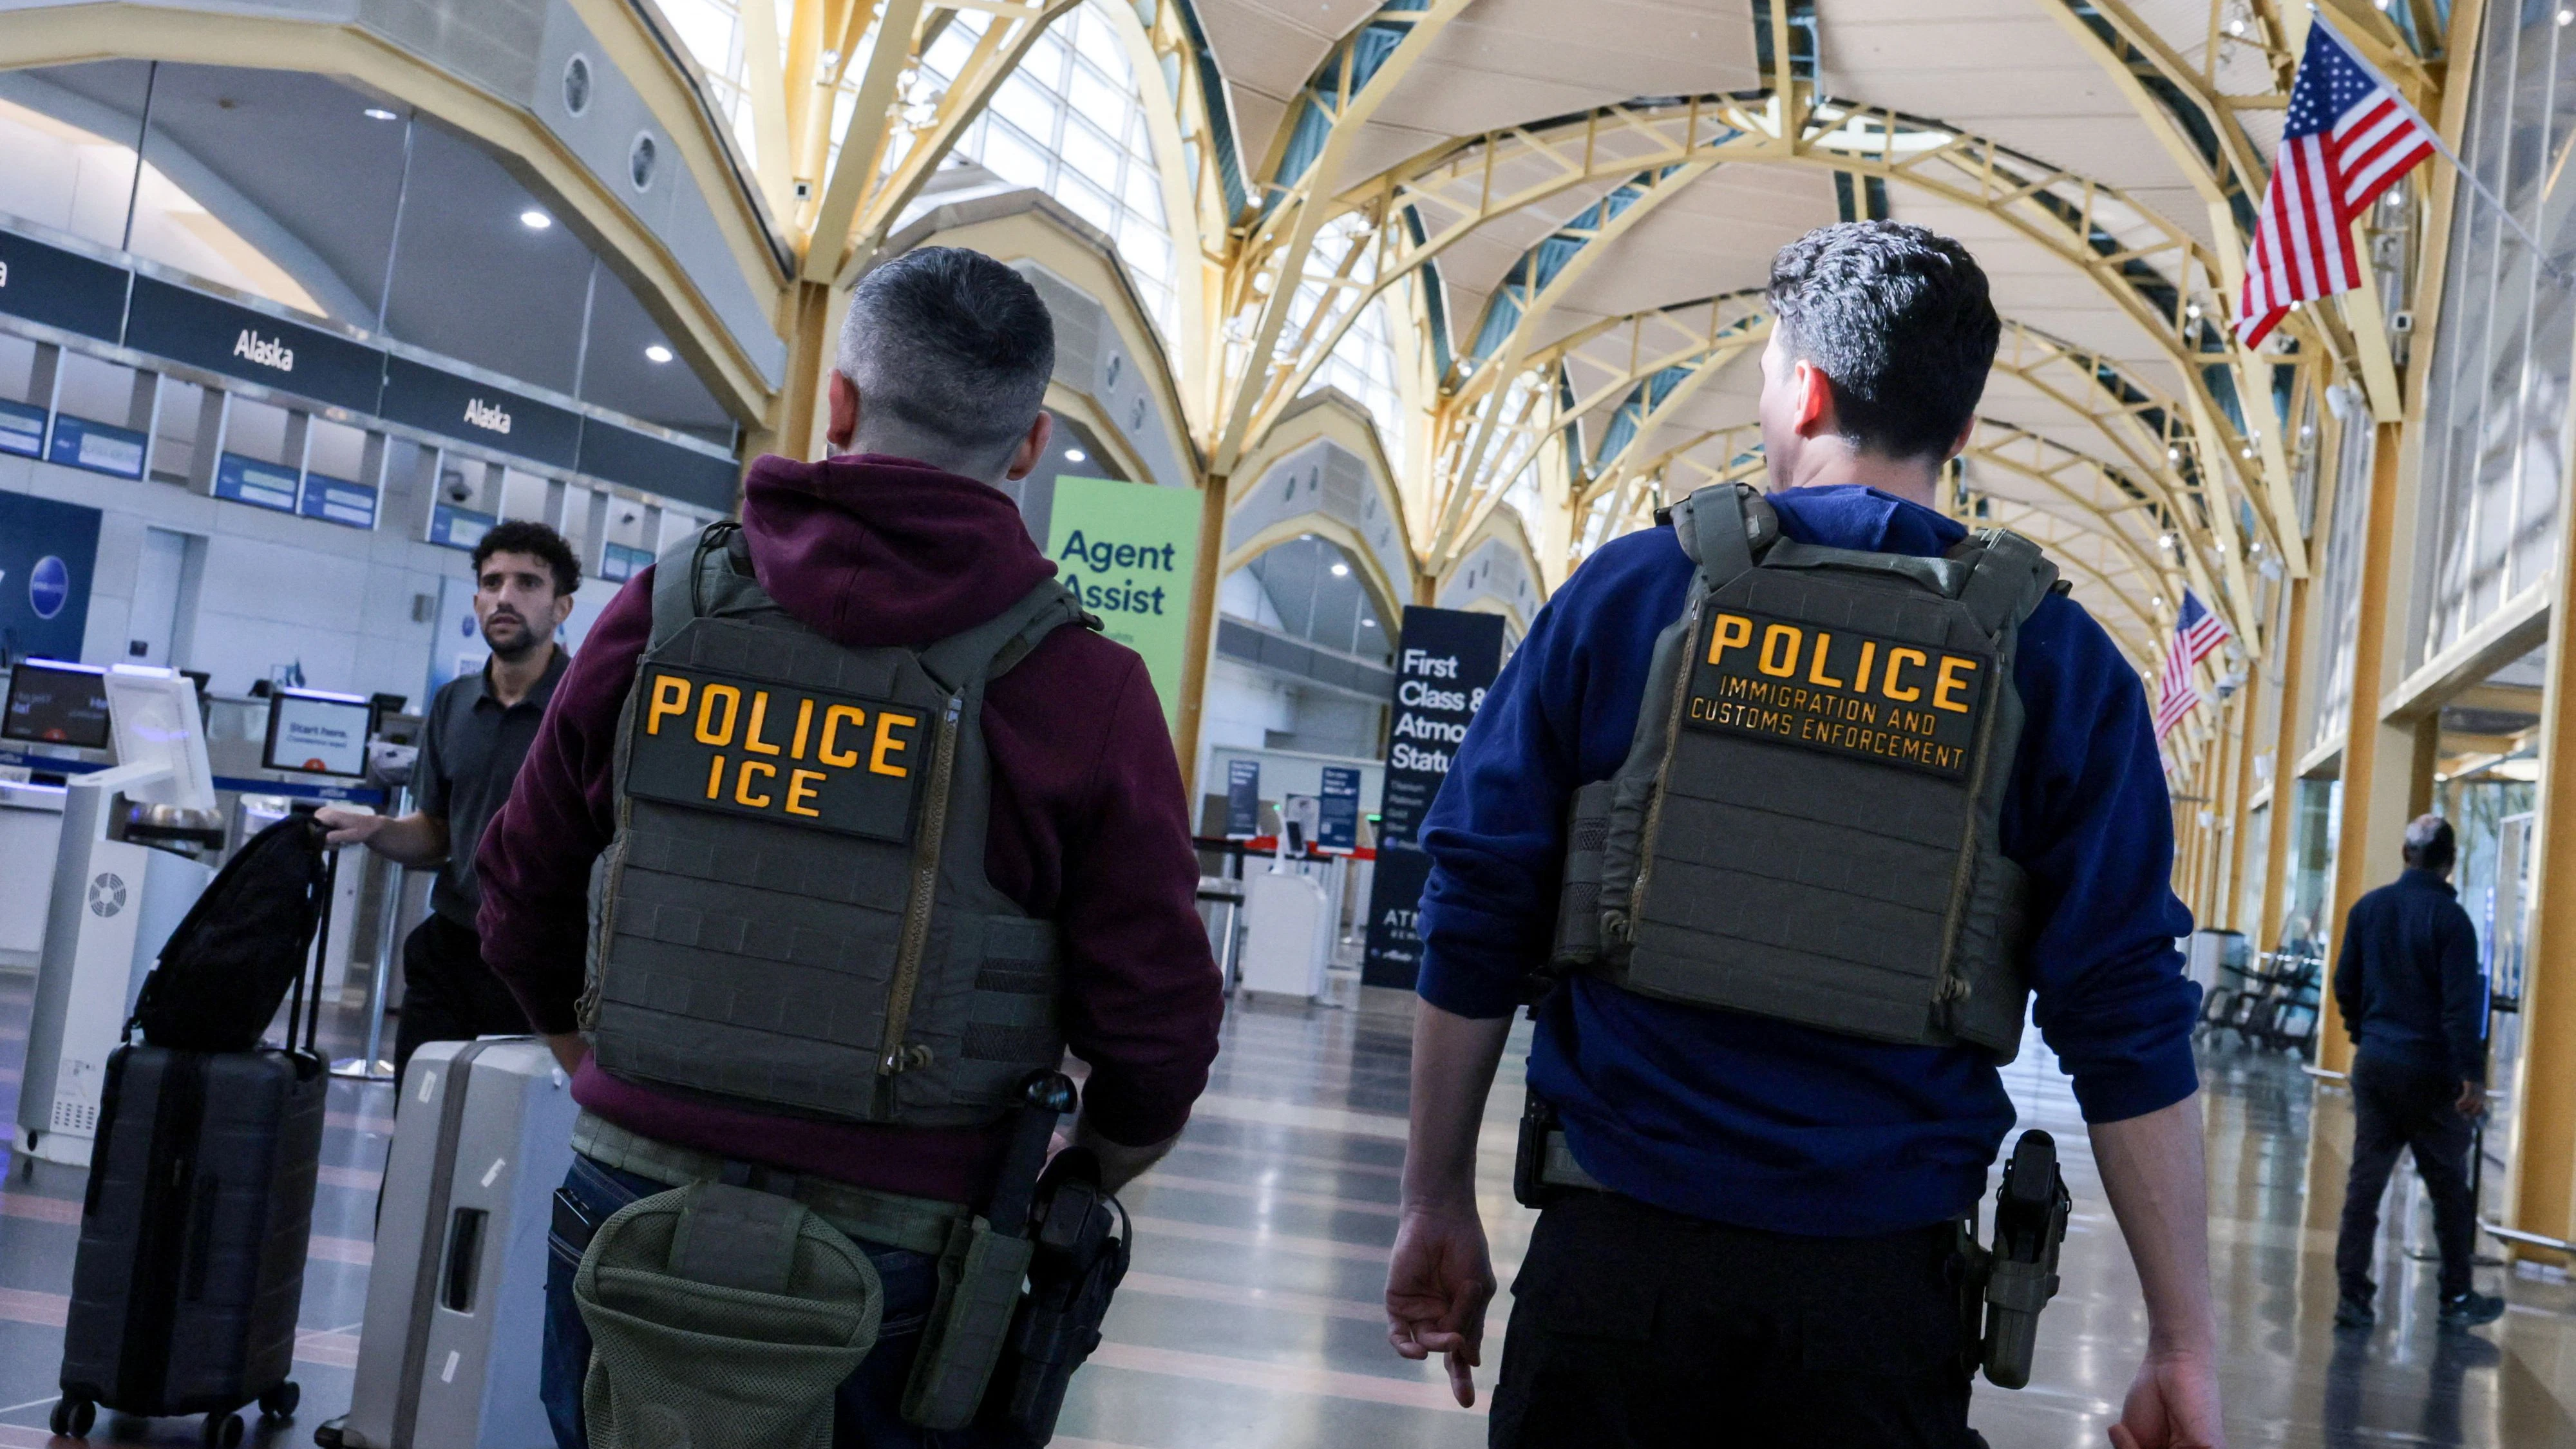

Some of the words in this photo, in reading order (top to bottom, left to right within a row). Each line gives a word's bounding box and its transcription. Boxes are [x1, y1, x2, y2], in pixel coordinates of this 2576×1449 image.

[233, 329, 293, 372] Alaska
[464, 398, 511, 434] Alaska
[1061, 529, 1176, 573] Agent
[1403, 649, 1459, 678] First
[1707, 613, 1976, 714] POLICE
[1399, 680, 1466, 712] Class
[1720, 676, 1877, 724] IMMIGRATION
[1887, 708, 1935, 735] AND
[647, 674, 916, 777] POLICE
[1394, 712, 1468, 743] Atmo
[1691, 697, 1793, 735] CUSTOMS
[1802, 718, 1963, 770] ENFORCEMENT
[1392, 743, 1449, 773] Statu
[706, 755, 827, 817] ICE
[1383, 909, 1418, 928] AT
